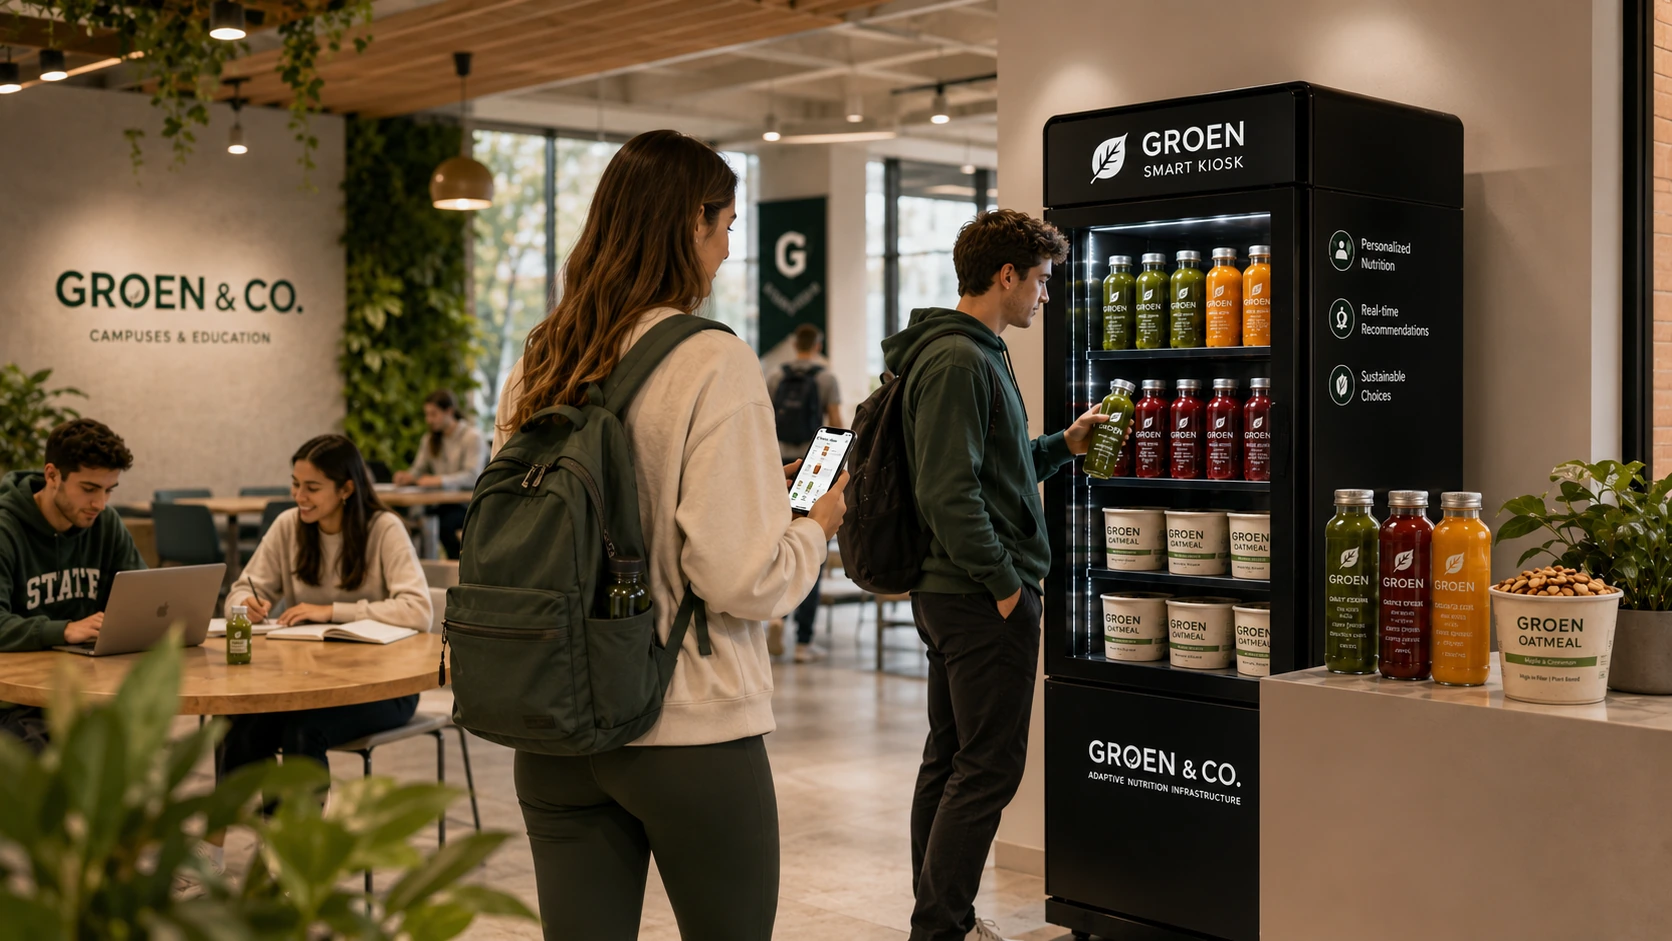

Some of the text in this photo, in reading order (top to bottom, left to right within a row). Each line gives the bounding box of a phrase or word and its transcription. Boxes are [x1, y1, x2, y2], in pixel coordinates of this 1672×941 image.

[1142, 120, 1245, 157] GROEN
[1144, 155, 1244, 178] SMART KIOSK
[1361, 238, 1411, 254] Personalized
[775, 231, 806, 278] G
[1361, 257, 1396, 271] Nutrition
[55, 270, 304, 314] GROEN & CO.
[1170, 301, 1197, 309] GROEN
[1206, 300, 1232, 308] GROEN
[1361, 304, 1399, 317] Real-time
[1361, 322, 1430, 337] Recommendations
[89, 329, 271, 344] CAMPUSES & EDUCATION
[1361, 370, 1406, 382] Sustainable
[1361, 389, 1391, 402] Choices
[1135, 431, 1161, 439] GROEN
[1170, 431, 1197, 439] GROEN
[1206, 431, 1233, 439] GROEN
[1244, 431, 1271, 439] GROEN
[1106, 526, 1140, 536] GROEN
[1168, 529, 1204, 540] GROEN
[1231, 531, 1270, 542] GROEN
[1170, 540, 1203, 549] OATMEAL
[1234, 543, 1268, 551] OATMEAL
[1329, 574, 1369, 585] GROEN
[1383, 577, 1424, 589] GROEN
[26, 567, 100, 610] STATE
[1434, 580, 1475, 592] GROEN
[1105, 613, 1141, 625] GROEN
[1170, 619, 1206, 631] GROEN
[1517, 616, 1584, 632] GROEN
[1107, 625, 1140, 634] OATMEAL
[1518, 635, 1582, 648] OATMEAL
[1088, 739, 1242, 788] GROEN & CO.
[1088, 771, 1241, 805] ADAPTIVE NUTRITION INFRASTRUCTURE
